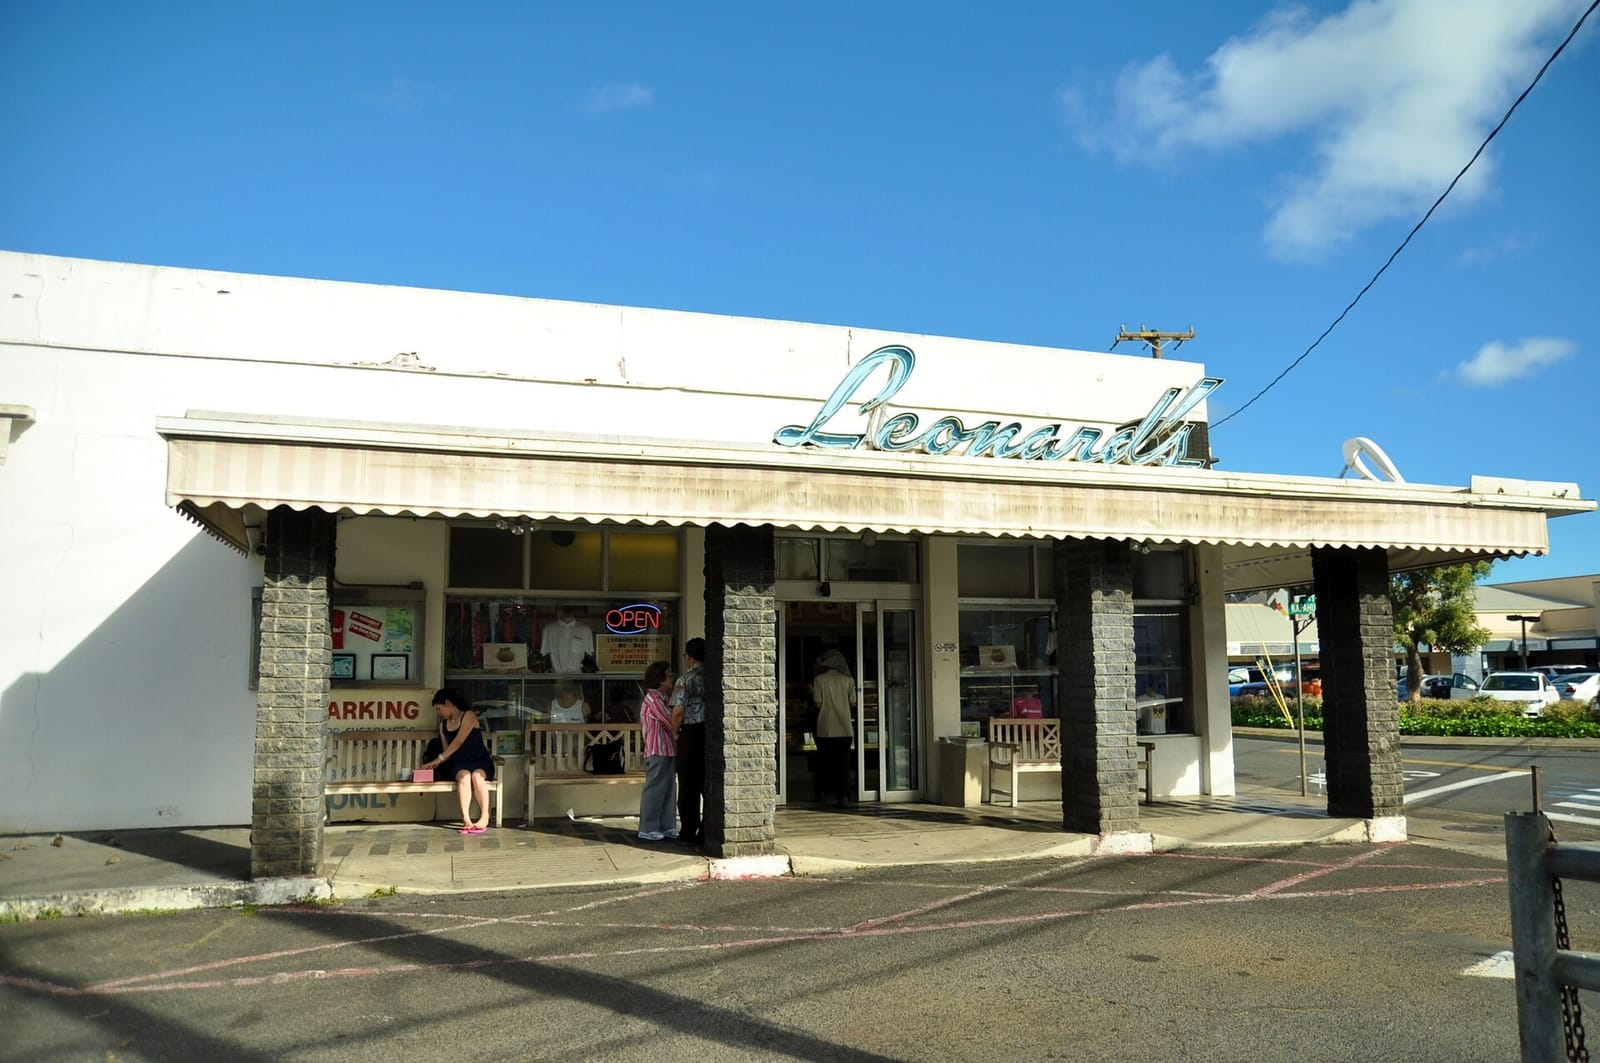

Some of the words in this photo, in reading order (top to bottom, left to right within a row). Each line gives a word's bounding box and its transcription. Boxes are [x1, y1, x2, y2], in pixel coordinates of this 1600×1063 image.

[606, 609, 660, 629] OPEN
[328, 701, 419, 720] ARKING
[328, 792, 400, 810] ONLY
